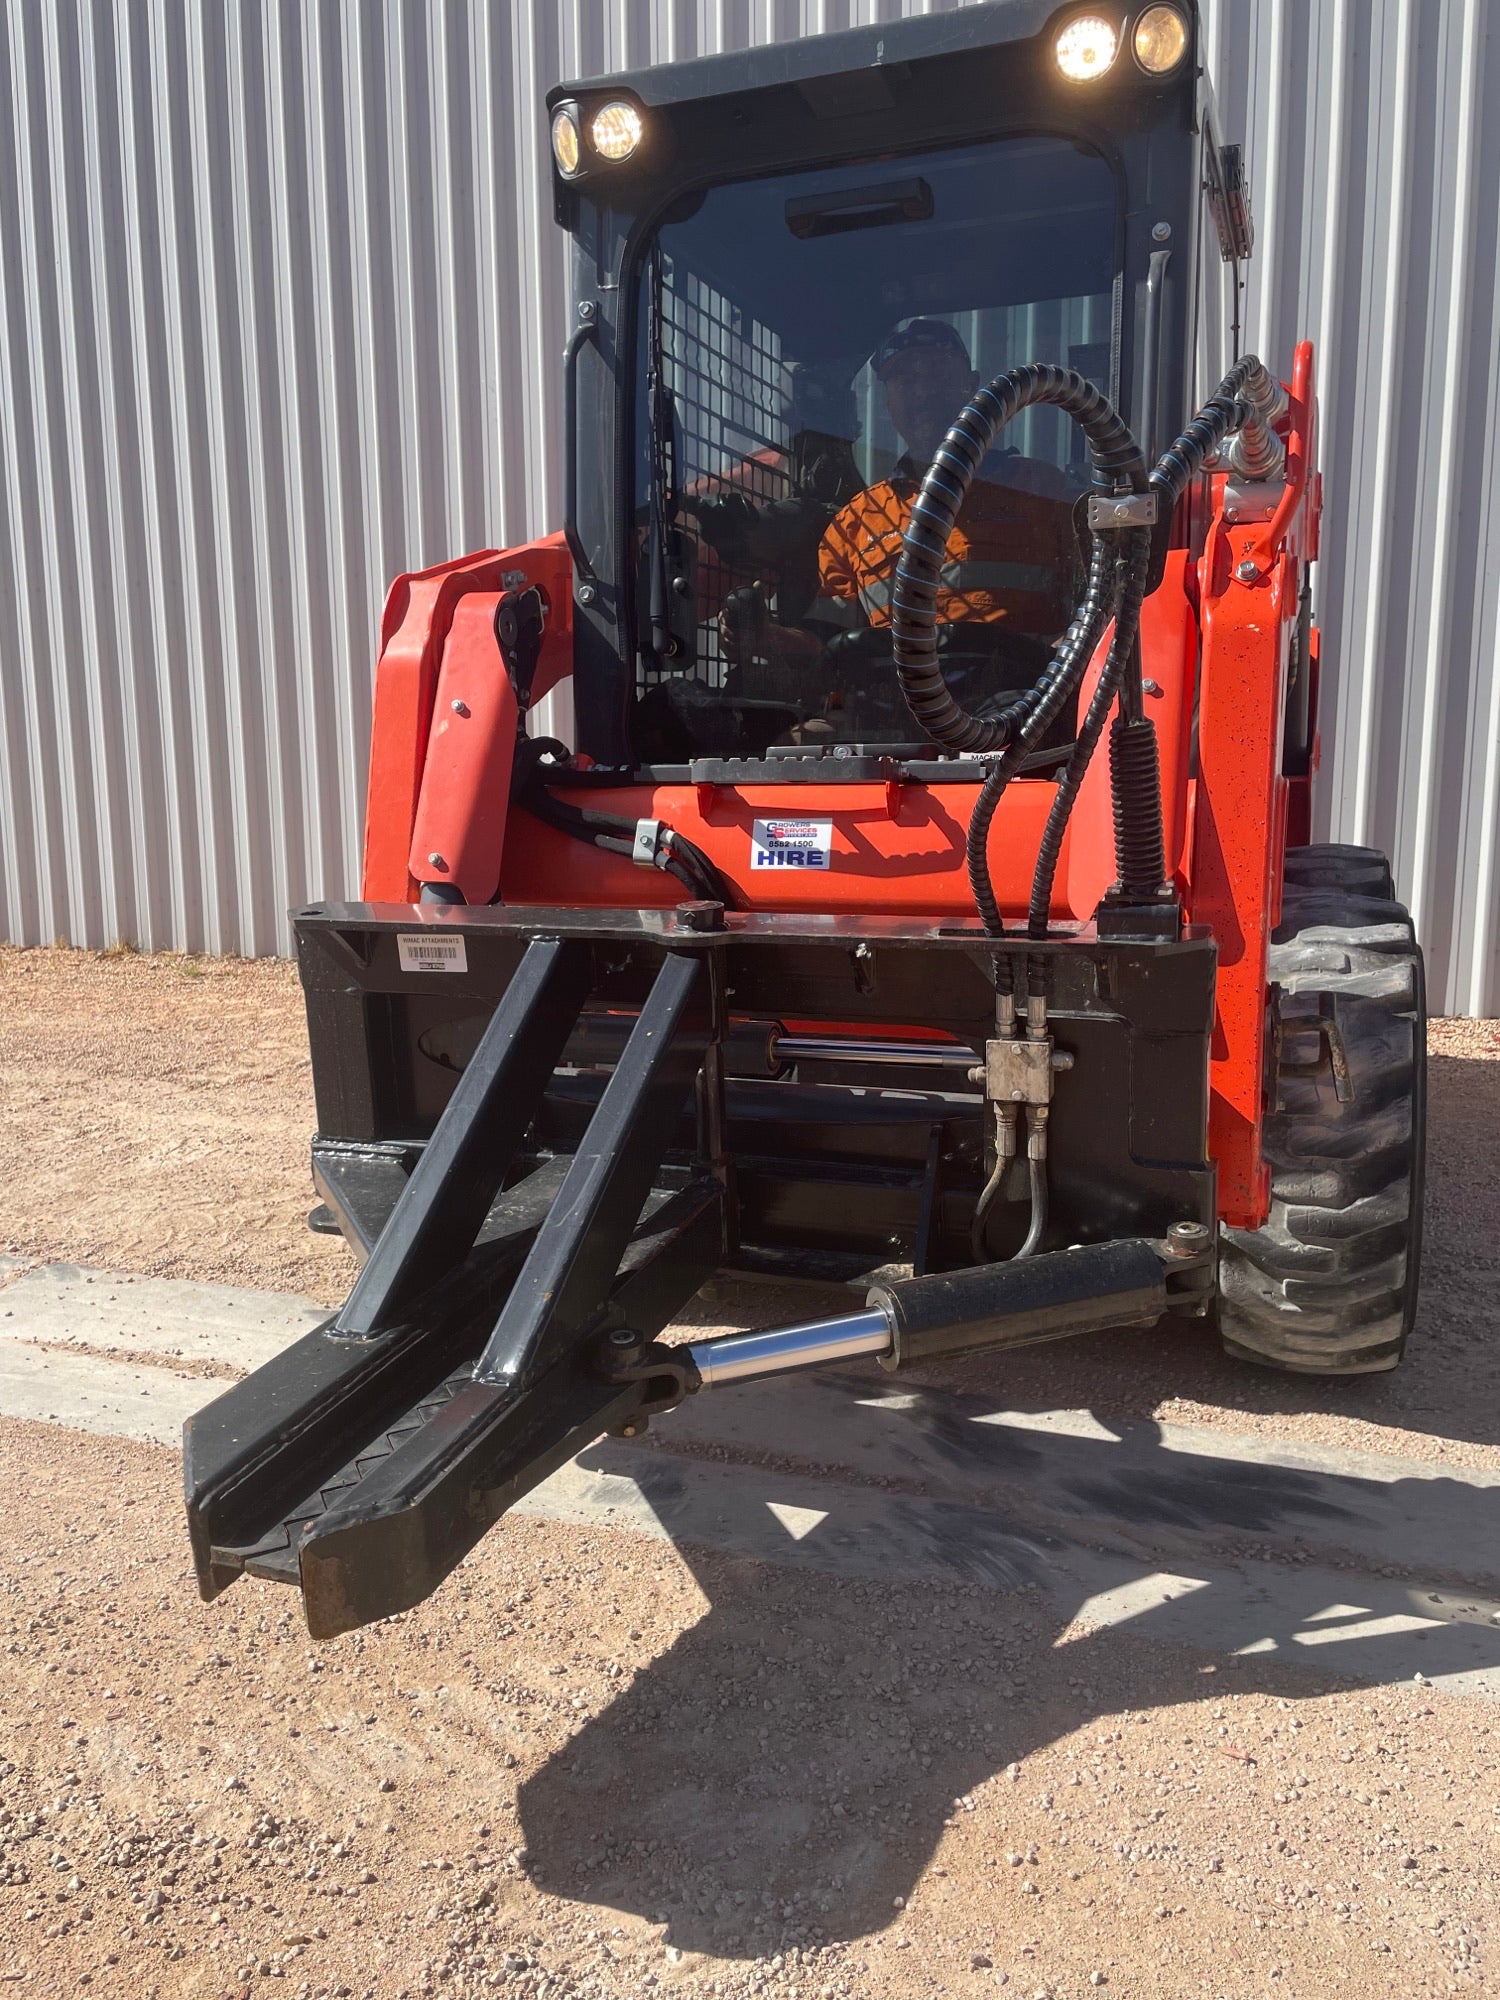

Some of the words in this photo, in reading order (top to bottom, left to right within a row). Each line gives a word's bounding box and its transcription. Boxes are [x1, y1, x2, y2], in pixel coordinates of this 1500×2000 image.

[767, 822, 811, 832] GROWERS
[773, 828, 817, 839] SERVICES
[757, 851, 824, 865] HIRE
